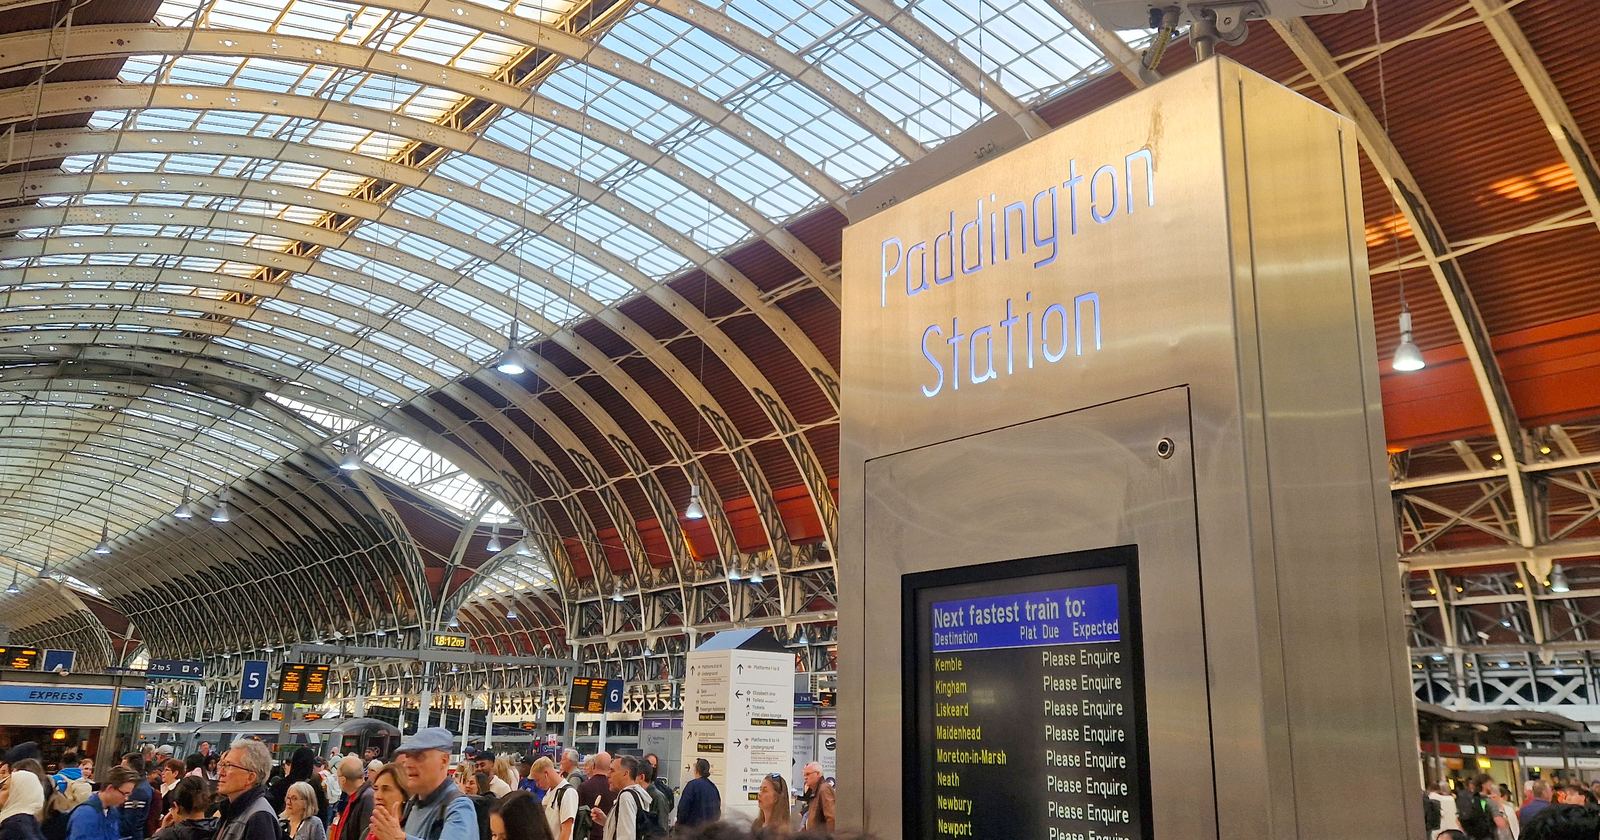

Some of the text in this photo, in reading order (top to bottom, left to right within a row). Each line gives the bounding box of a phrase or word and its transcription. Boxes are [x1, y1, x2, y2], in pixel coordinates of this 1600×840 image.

[880, 148, 1154, 308] Paddington
[921, 291, 1101, 398] Station
[934, 596, 1086, 628] Next fastest train to:
[934, 619, 1120, 646] Destination Plat Due Expected
[934, 649, 1121, 671] Kemble Please Enquire
[248, 672, 260, 688] 5
[935, 675, 1122, 697] Kingham Please Enquire
[29, 690, 84, 701] EXPRESS
[610, 689, 619, 702] 6
[936, 700, 1124, 719] Liskeard Please Enquire
[936, 725, 1125, 746] Maidenhead Please Enquire
[936, 748, 1126, 772] Moreton-in-Marsh Please Enquire
[937, 772, 1128, 798] Neath Please Enquire
[938, 796, 1130, 826] Newbury Please Enquire
[938, 819, 972, 838] Newport
